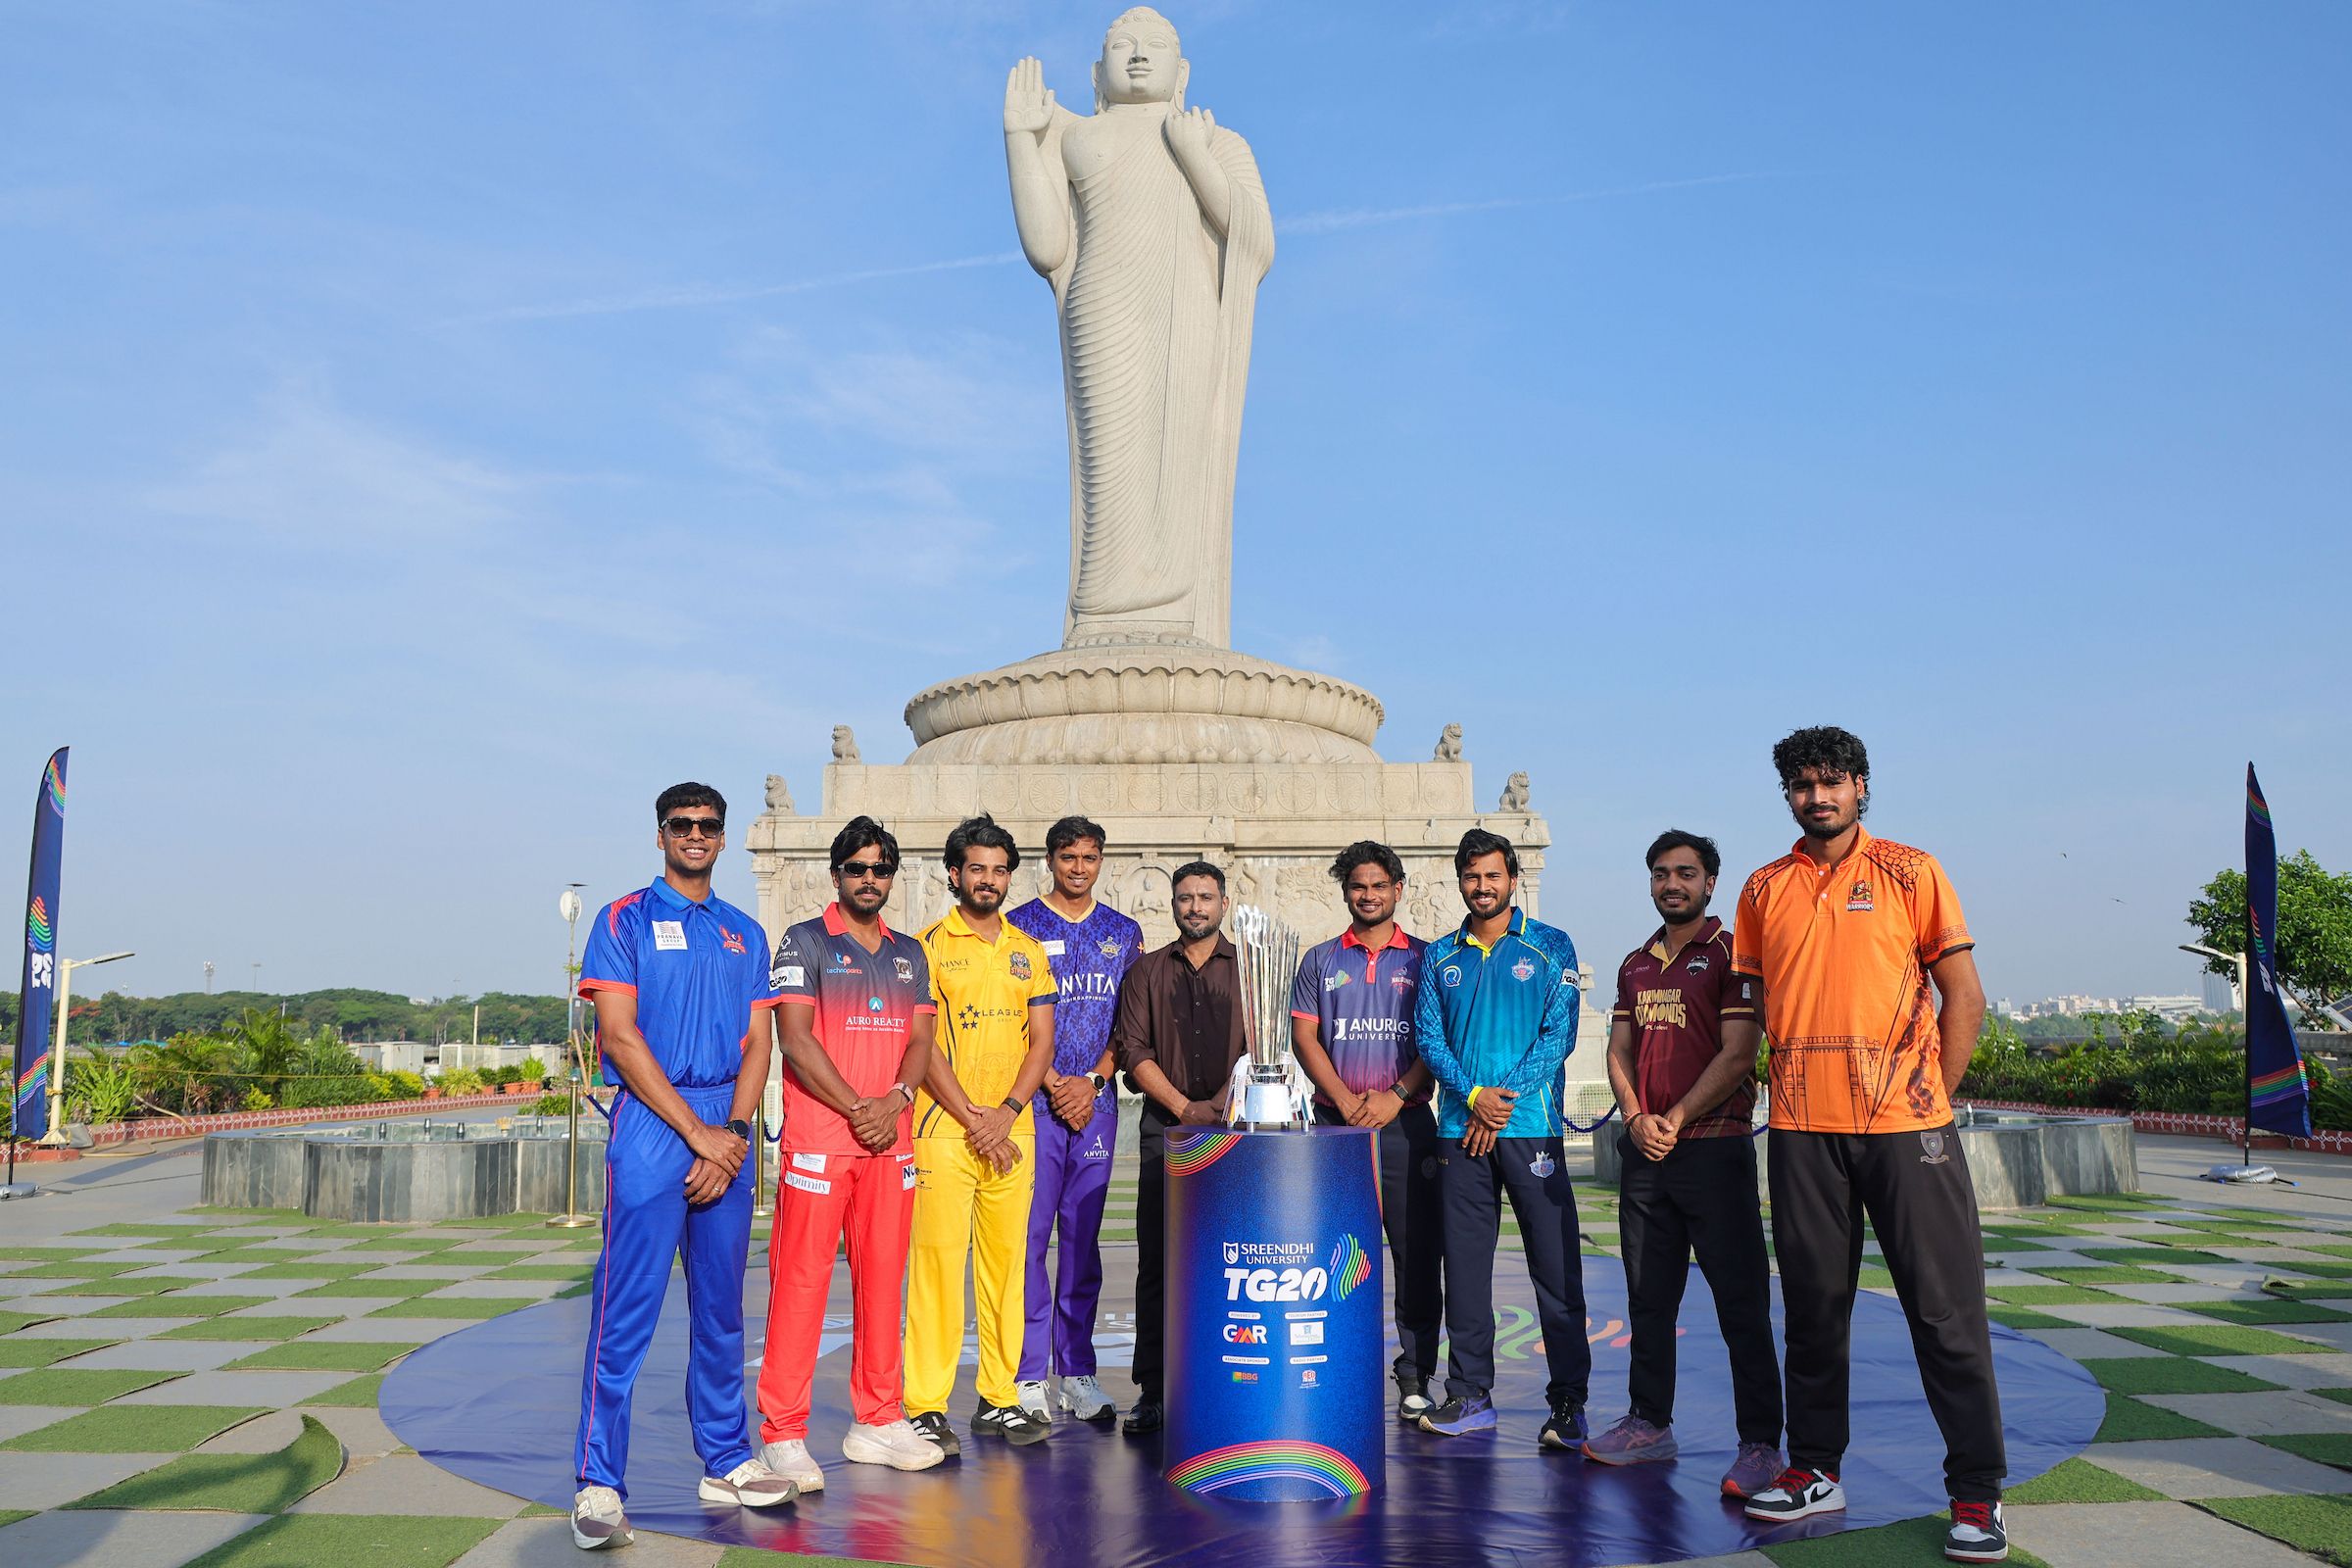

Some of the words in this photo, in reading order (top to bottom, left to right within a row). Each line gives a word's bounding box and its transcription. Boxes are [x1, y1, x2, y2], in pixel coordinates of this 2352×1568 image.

[846, 1016, 871, 1026] AURO
[1241, 1243, 1314, 1255] SREENIDHI
[1246, 1255, 1308, 1265] UNIVERSITY
[1223, 1266, 1328, 1302] TG20
[1222, 1323, 1268, 1345] GMR
[1242, 1372, 1258, 1381] BBG
